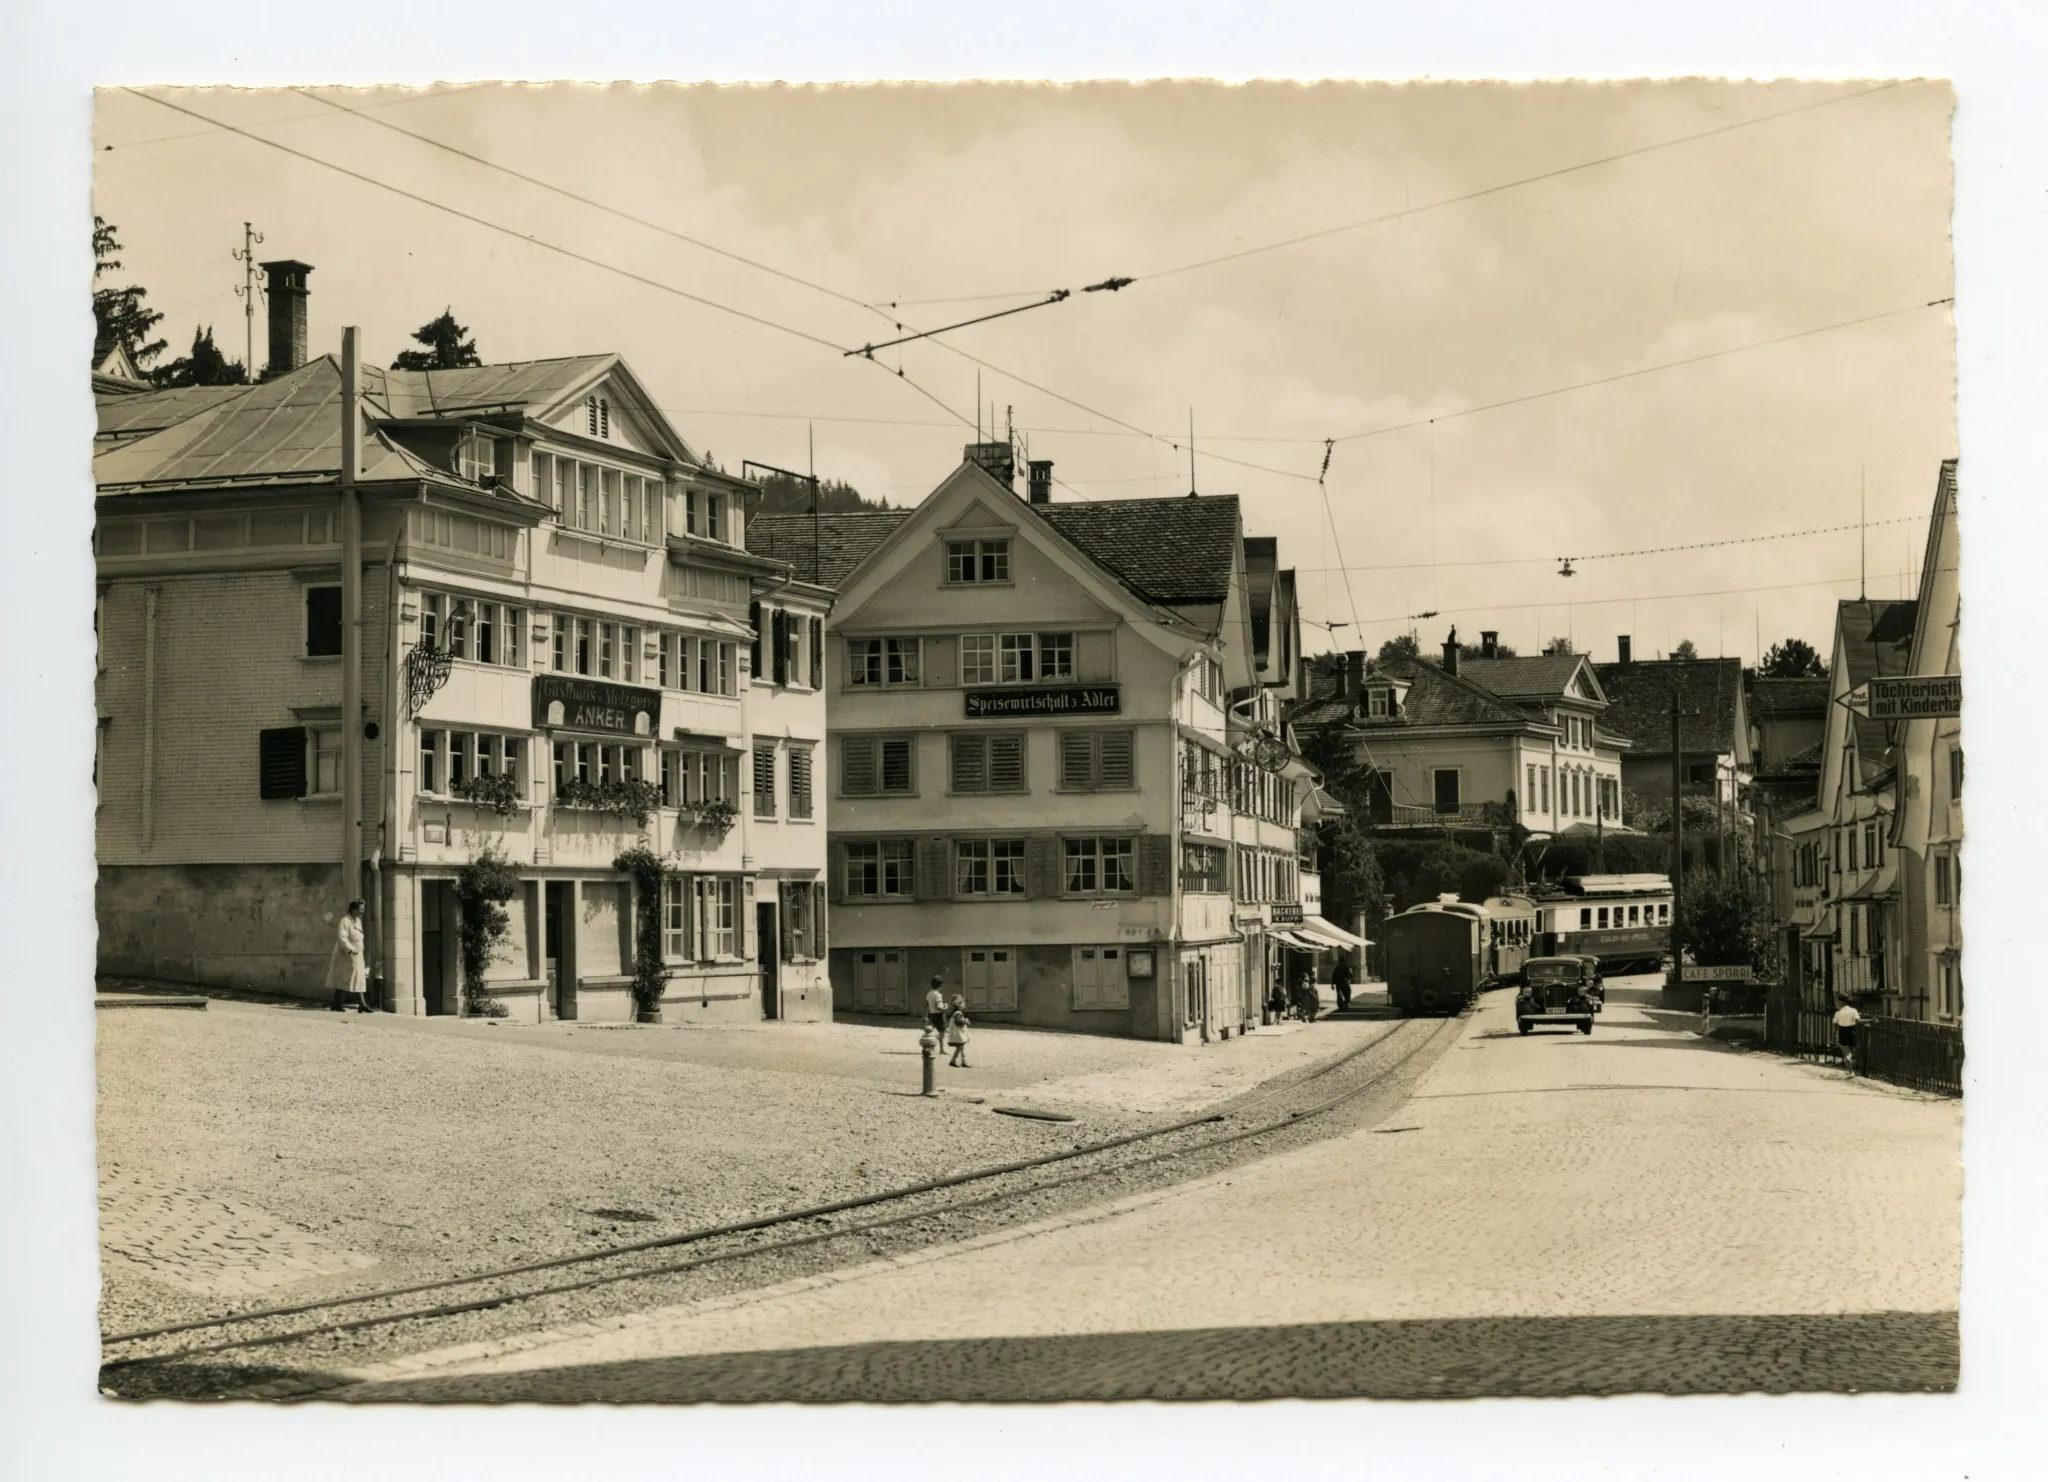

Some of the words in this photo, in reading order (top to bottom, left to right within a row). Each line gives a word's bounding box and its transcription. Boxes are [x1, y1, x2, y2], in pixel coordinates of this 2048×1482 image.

[1080, 691, 1115, 707] Adler
[1876, 701, 1896, 715] mit
[1900, 697, 1960, 714] Kinderha
[575, 705, 625, 729] ANKER
